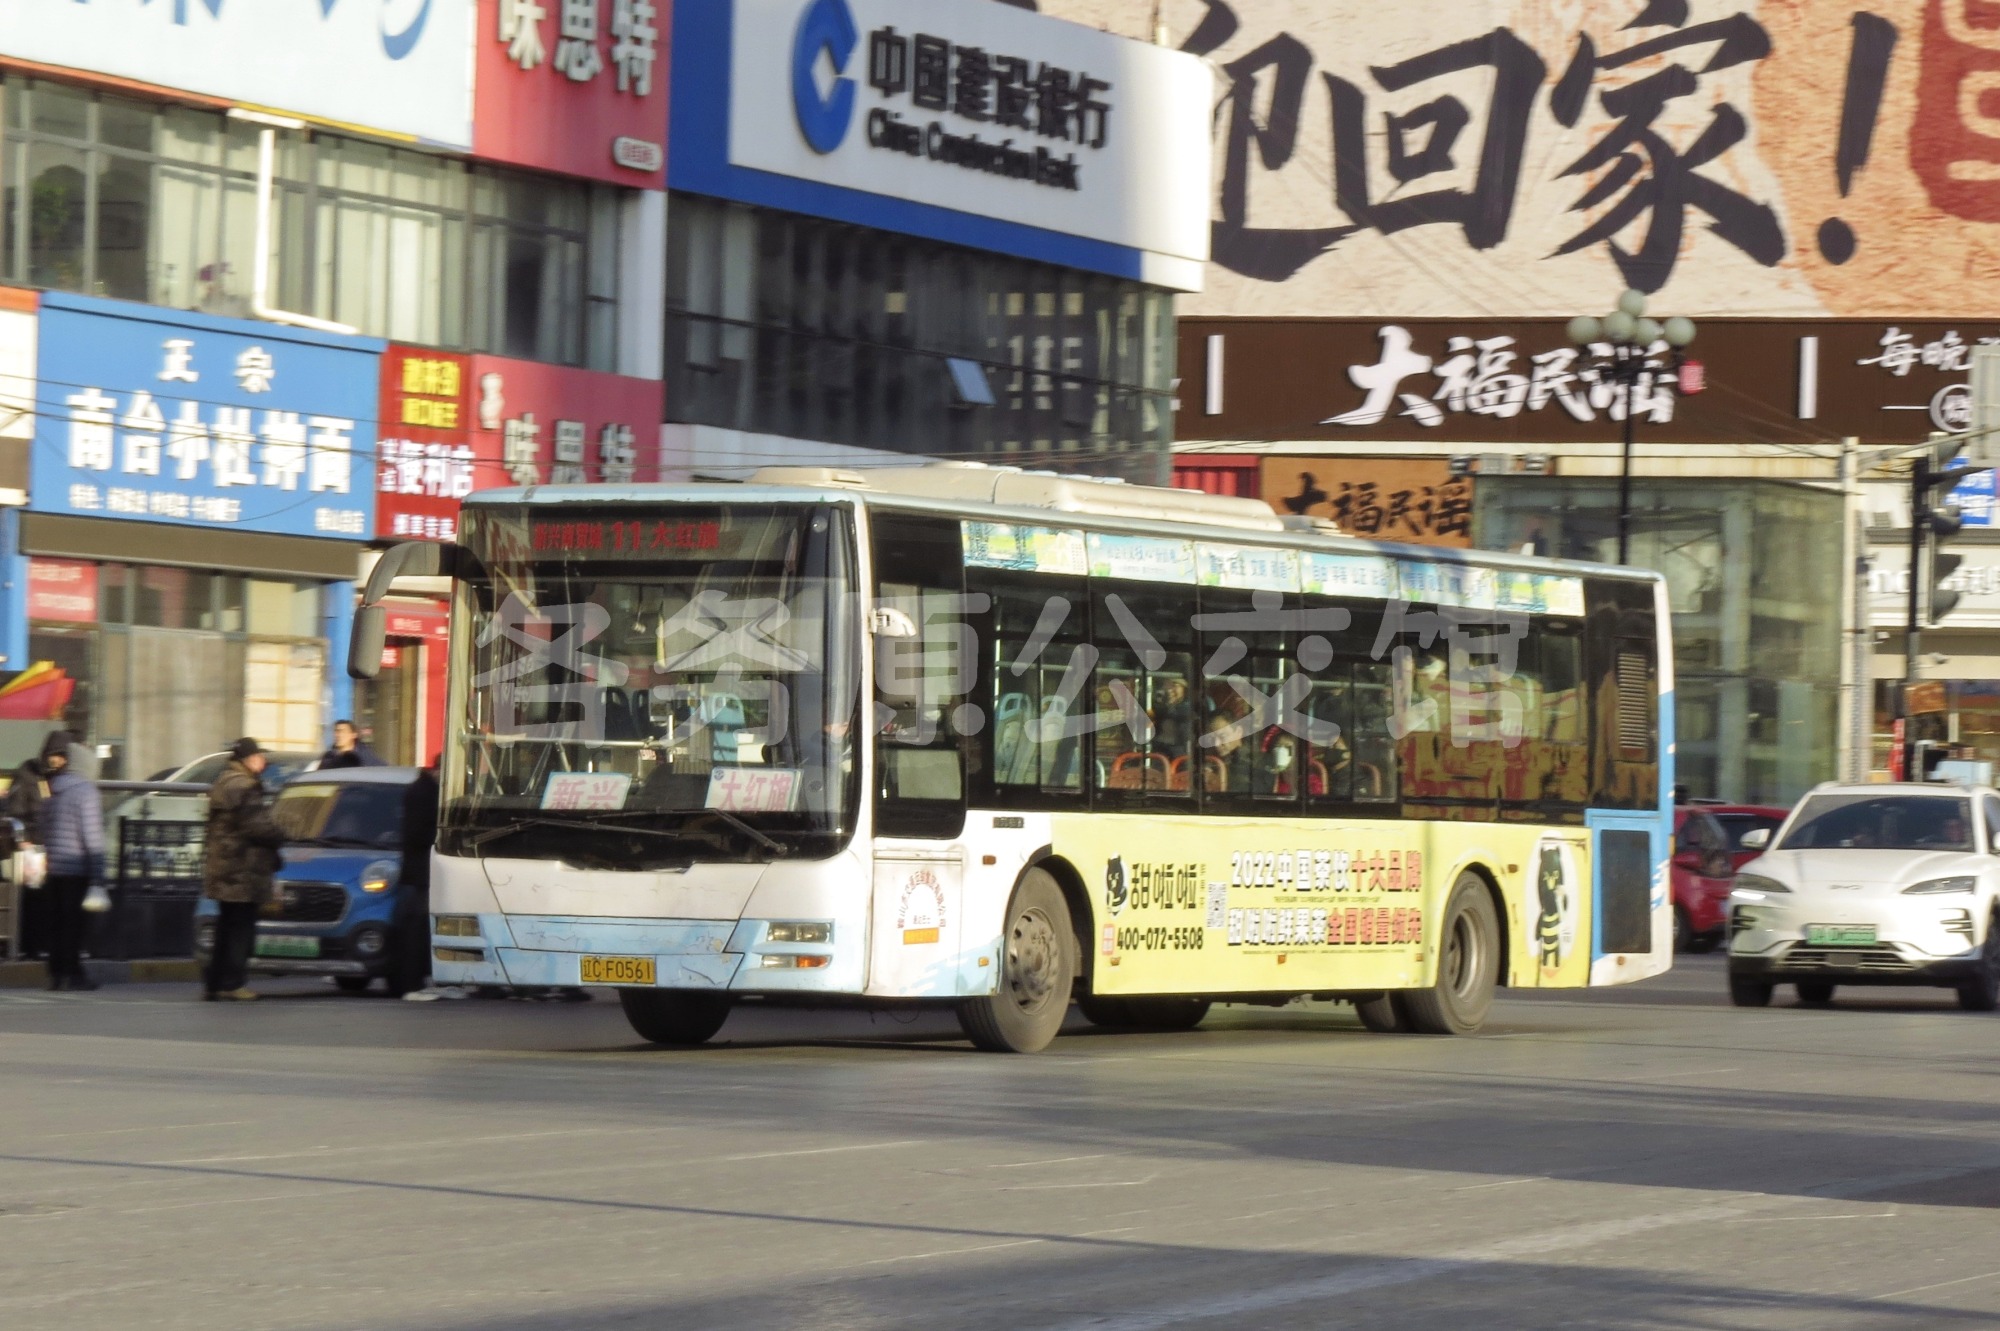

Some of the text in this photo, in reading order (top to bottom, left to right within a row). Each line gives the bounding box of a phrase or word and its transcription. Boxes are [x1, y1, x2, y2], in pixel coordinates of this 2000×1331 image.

[869, 26, 1112, 149] 中国建设银行
[612, 520, 642, 551] 11
[650, 520, 721, 549] 大红旗
[718, 770, 793, 812] 大红旗
[1131, 863, 1198, 910] 甜啦啦
[1117, 926, 1204, 951] 400-072-5508
